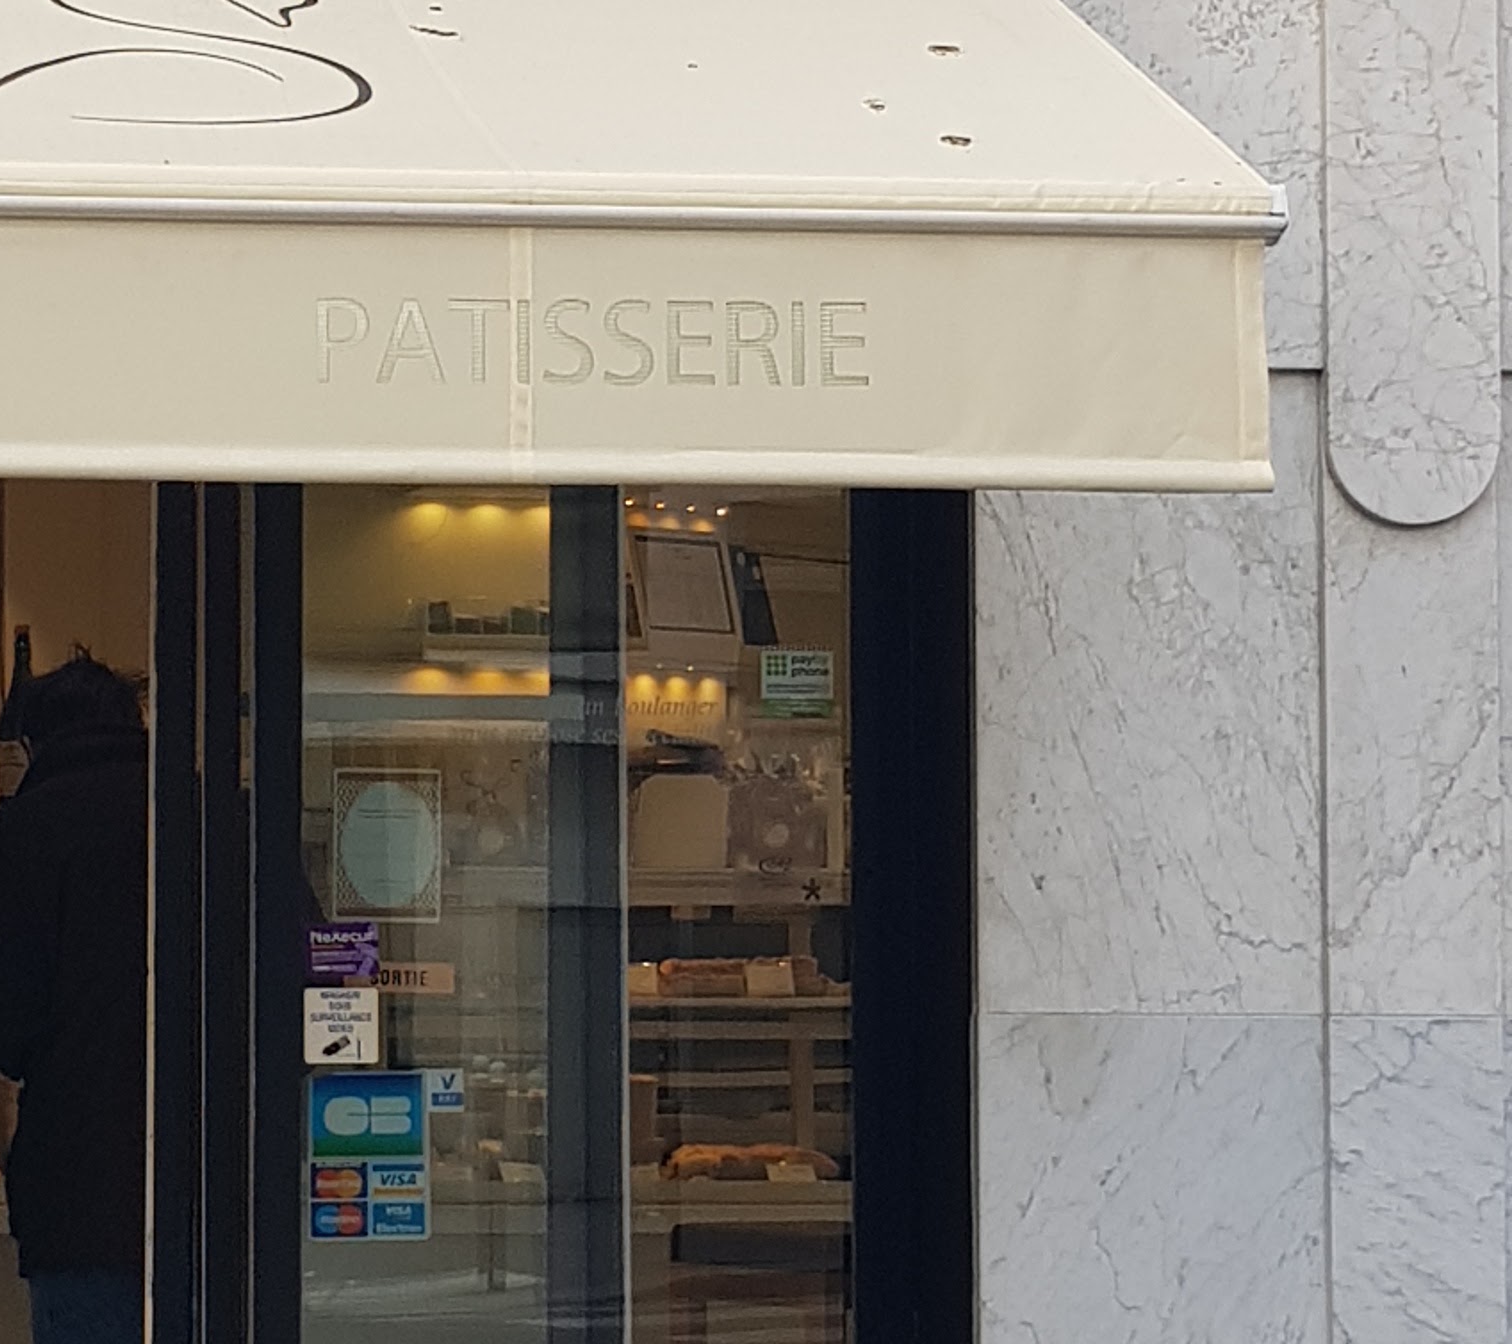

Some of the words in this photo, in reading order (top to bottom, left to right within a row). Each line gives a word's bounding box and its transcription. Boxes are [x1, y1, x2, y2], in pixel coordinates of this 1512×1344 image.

[314, 296, 870, 387] PATISSERIE
[615, 694, 720, 719] oulanger
[379, 1172, 417, 1186] VISA
